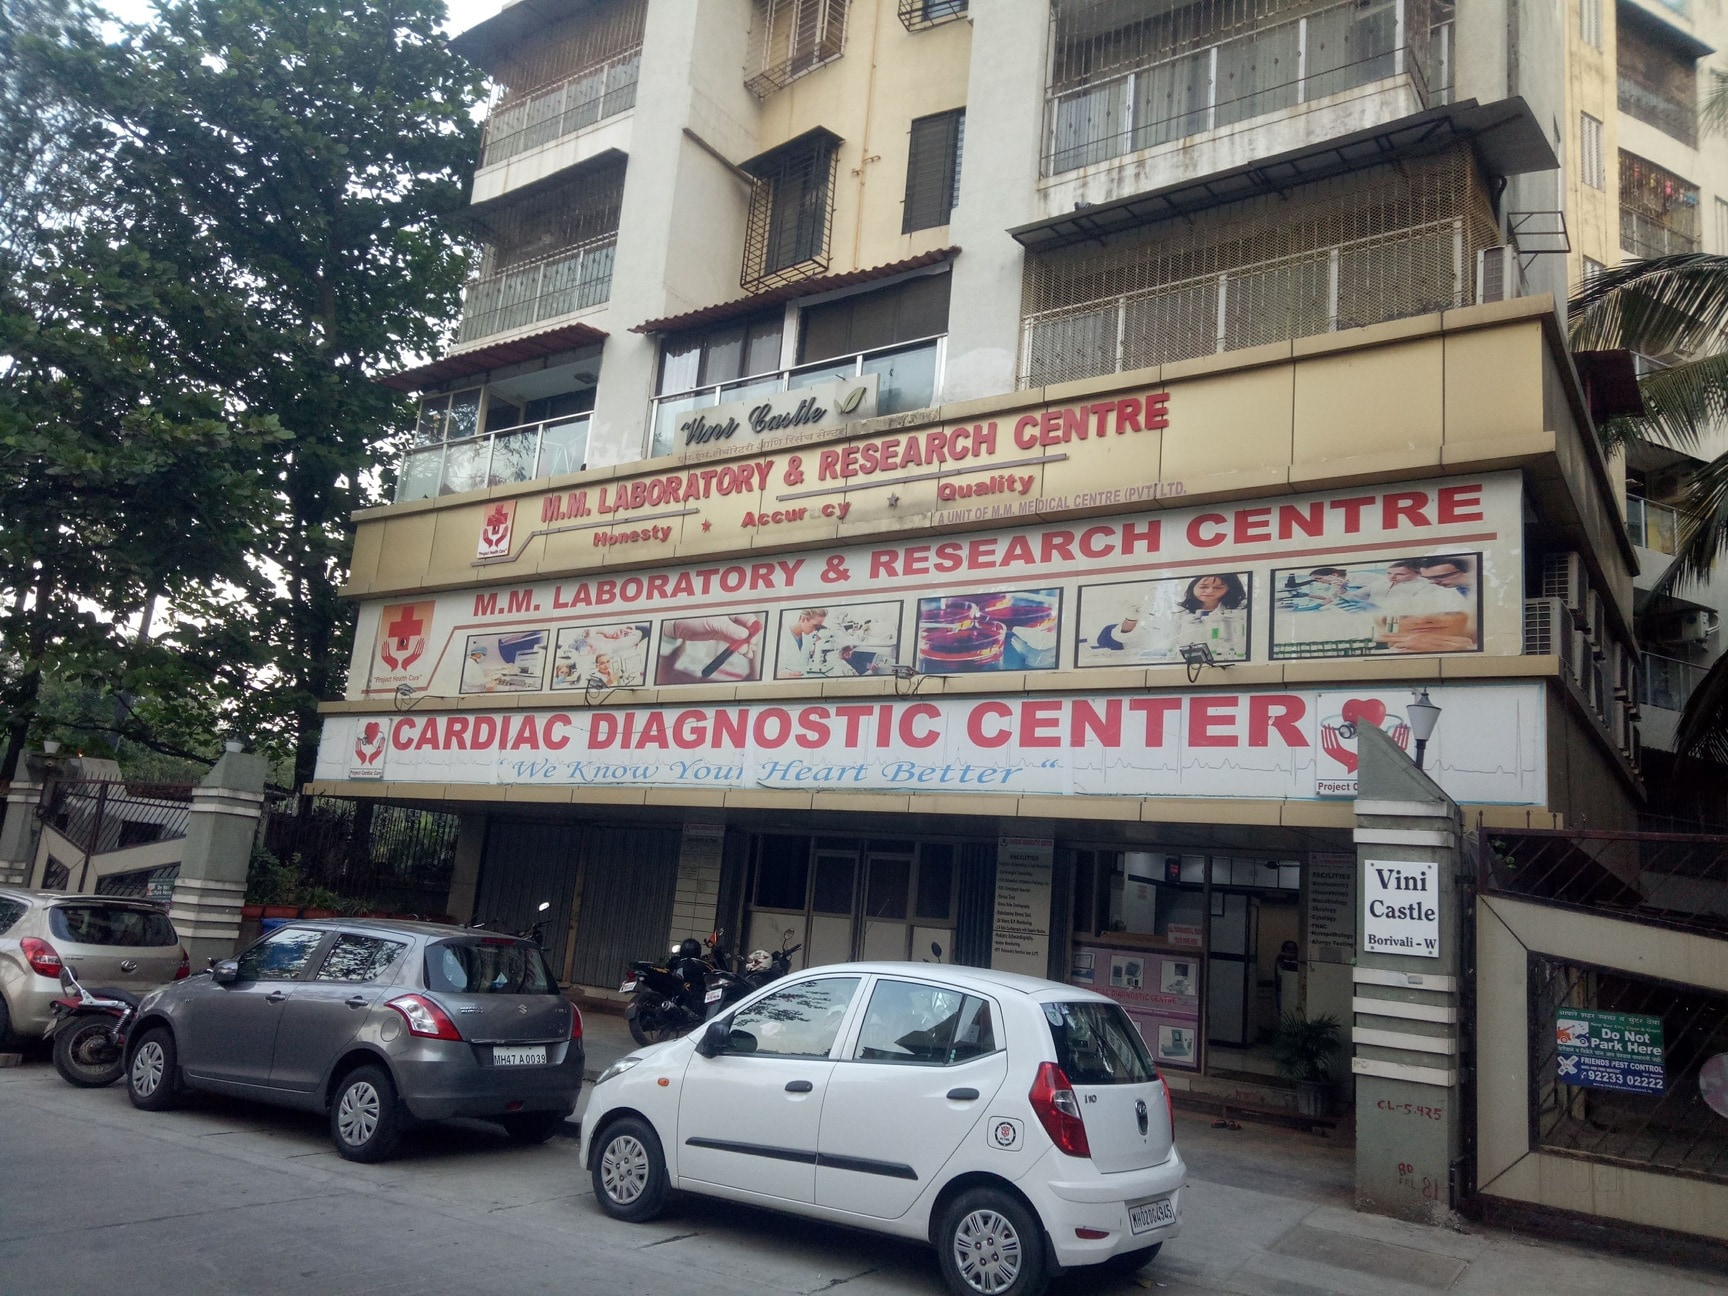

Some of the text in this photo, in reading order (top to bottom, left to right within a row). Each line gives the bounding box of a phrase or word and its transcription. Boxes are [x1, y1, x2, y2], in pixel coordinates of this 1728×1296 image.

[680, 397, 828, 446] Vini Castle
[541, 392, 1170, 522] M.M. LABORATORY & RESEARCH CENTRE
[938, 473, 1035, 501] Quality
[936, 512, 945, 524] A
[948, 508, 973, 523] UNIT
[974, 506, 989, 519] OF
[991, 502, 1015, 518] M.M.
[1018, 495, 1070, 514] MEDICAL
[1073, 489, 1121, 508] CENTRE
[1160, 481, 1187, 498] LTD.
[592, 524, 673, 548] Honesty
[473, 484, 1483, 616] M.M. LABORATORY & RESEARCH CENTRE
[391, 694, 1310, 751] CARDIAC DIAGNOSTIC CENTER
[567, 759, 660, 782] Know
[757, 760, 868, 784] Heart
[881, 760, 1024, 784] Better
[1318, 782, 1350, 792] Project
[1375, 868, 1428, 892] Vini
[1369, 900, 1436, 921] Castle
[1368, 933, 1414, 948] Borivali
[1591, 1038, 1623, 1051] Park
[1627, 1042, 1662, 1056] Here
[1601, 1028, 1650, 1044] Do Not
[494, 1054, 546, 1065] MH47 A0039
[1581, 1056, 1610, 1067] FRIENDS
[1611, 1060, 1629, 1069] PEST
[1630, 1062, 1664, 1074] CONTROL
[1588, 1070, 1664, 1089] 92233 02222
